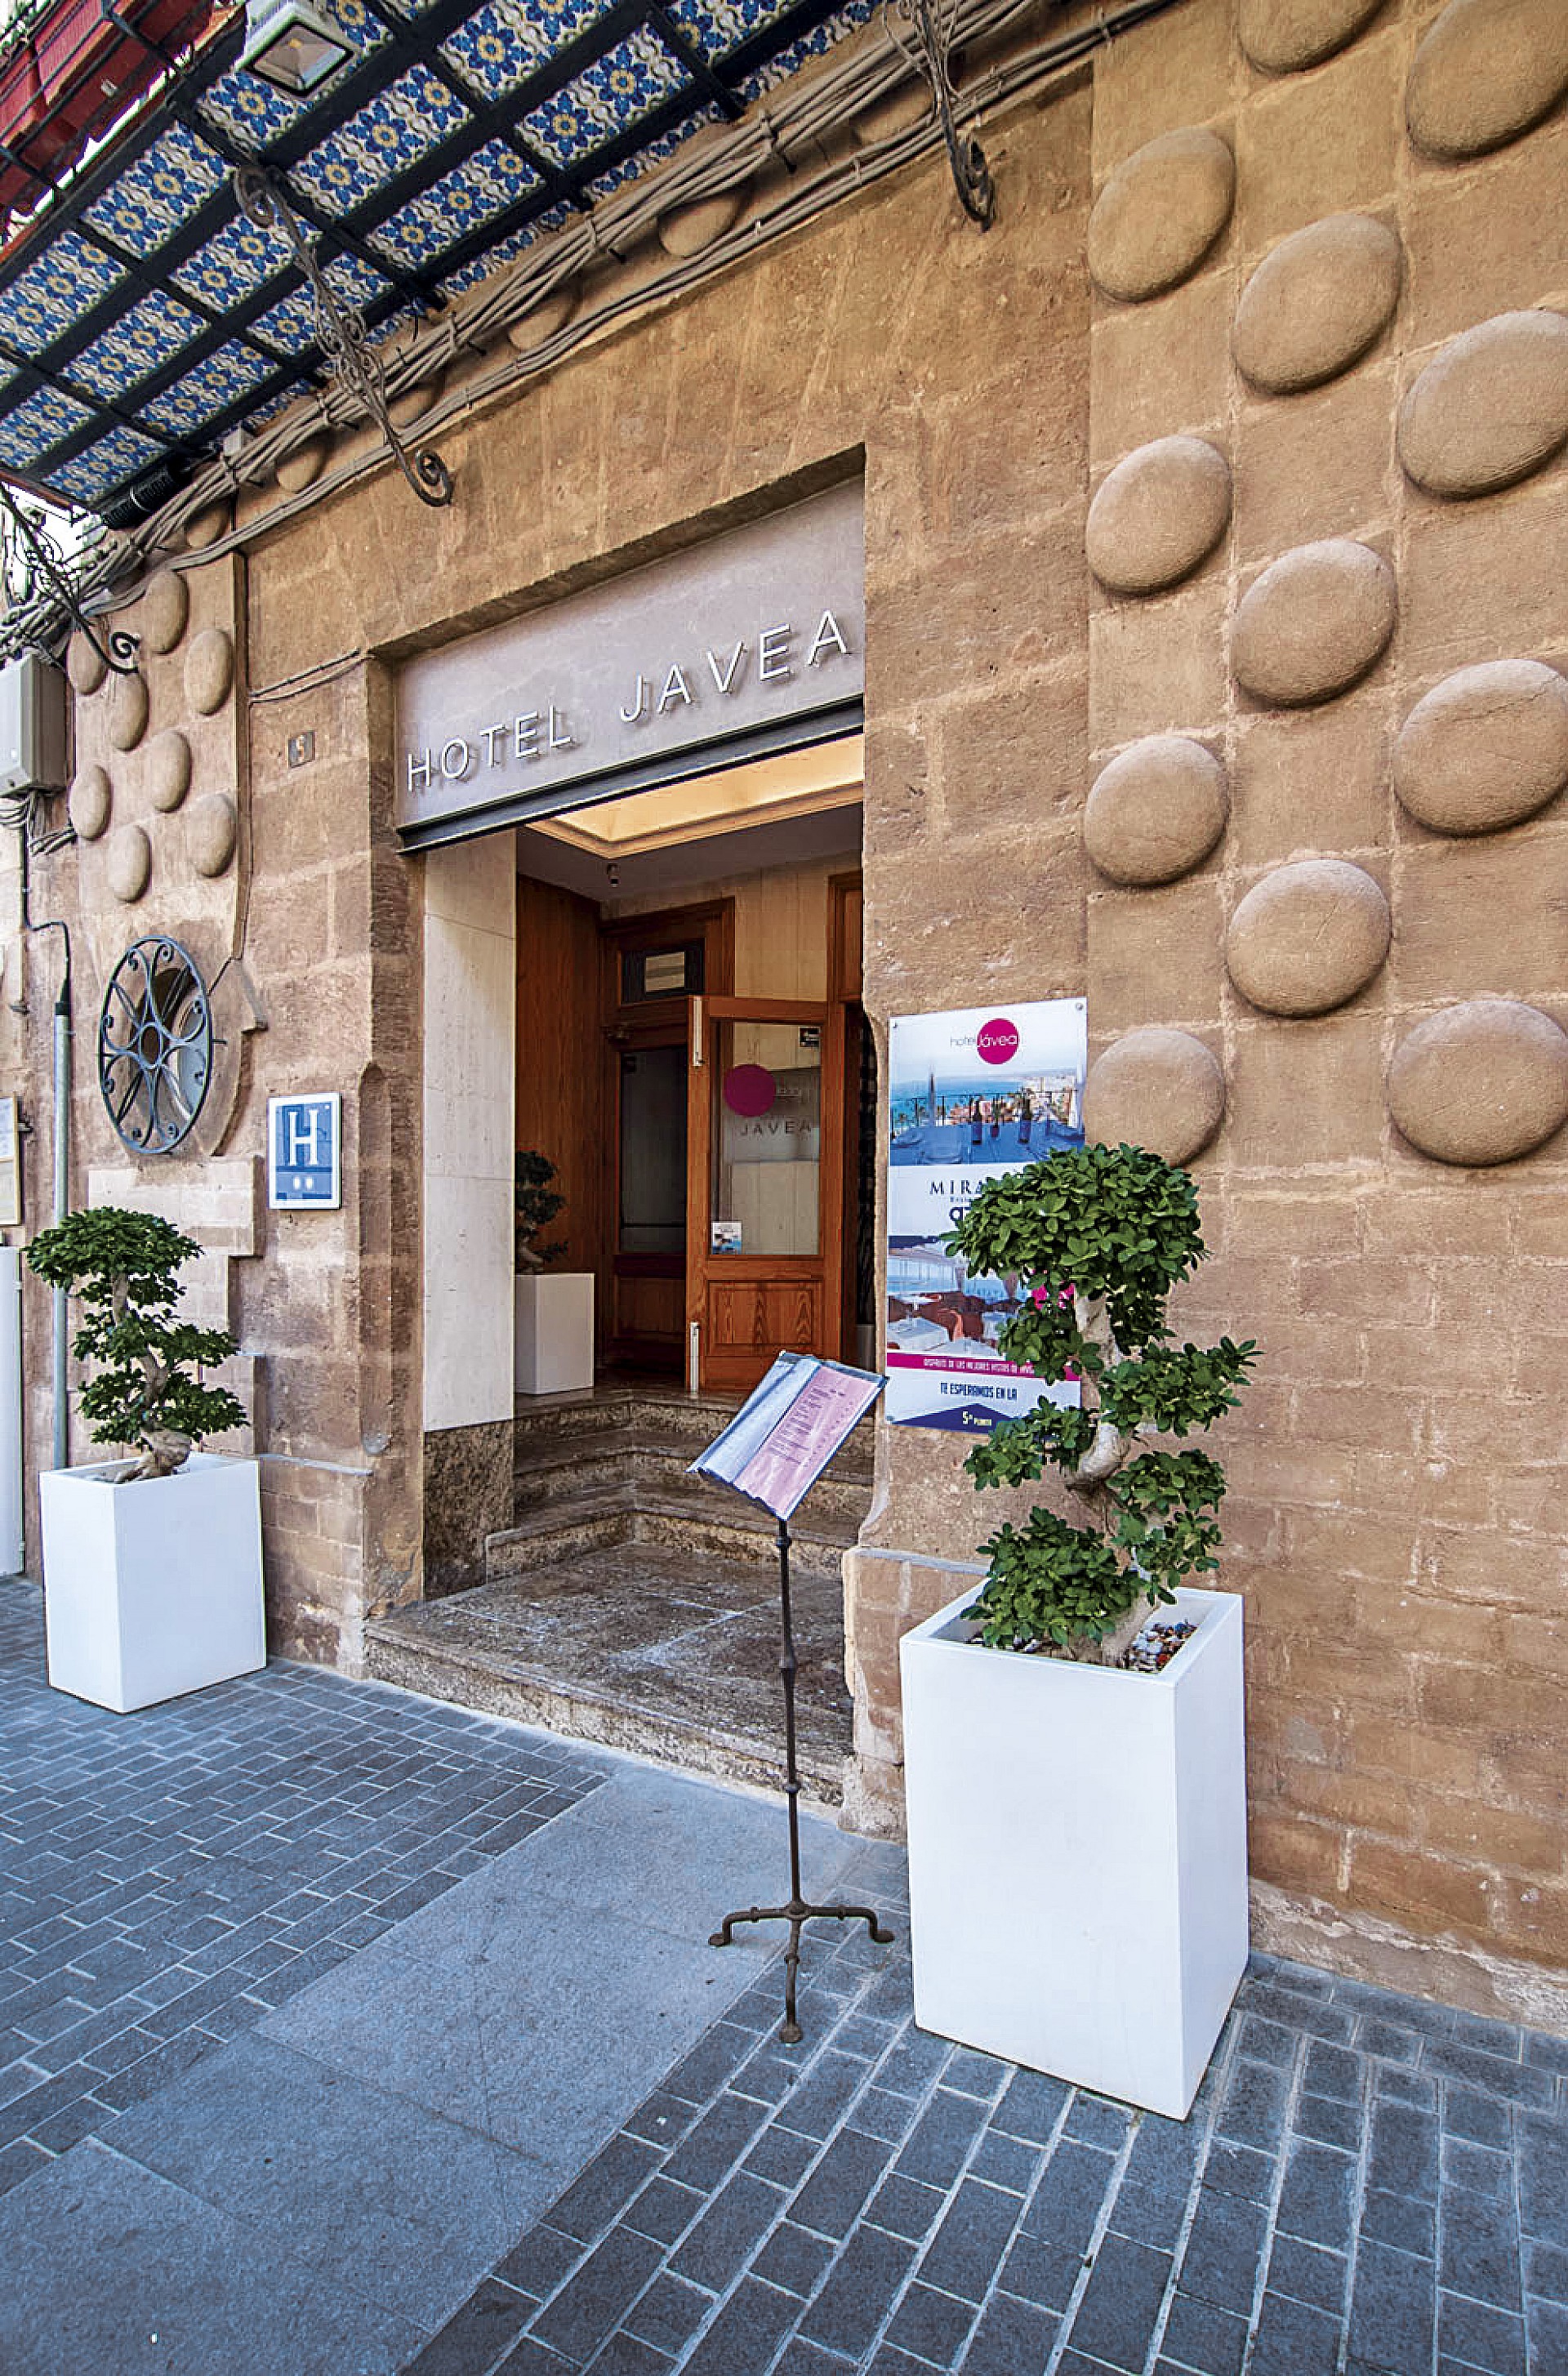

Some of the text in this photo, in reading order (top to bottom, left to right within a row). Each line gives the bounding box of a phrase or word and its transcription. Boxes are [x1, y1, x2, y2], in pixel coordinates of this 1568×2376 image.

[408, 609, 849, 791] HOTEL JAVEA
[951, 1033, 976, 1048] hotel
[741, 1119, 812, 1136] JAVEA
[288, 1109, 318, 1166] H
[940, 1382, 1018, 1401] TE ESPERAMOS EN LA
